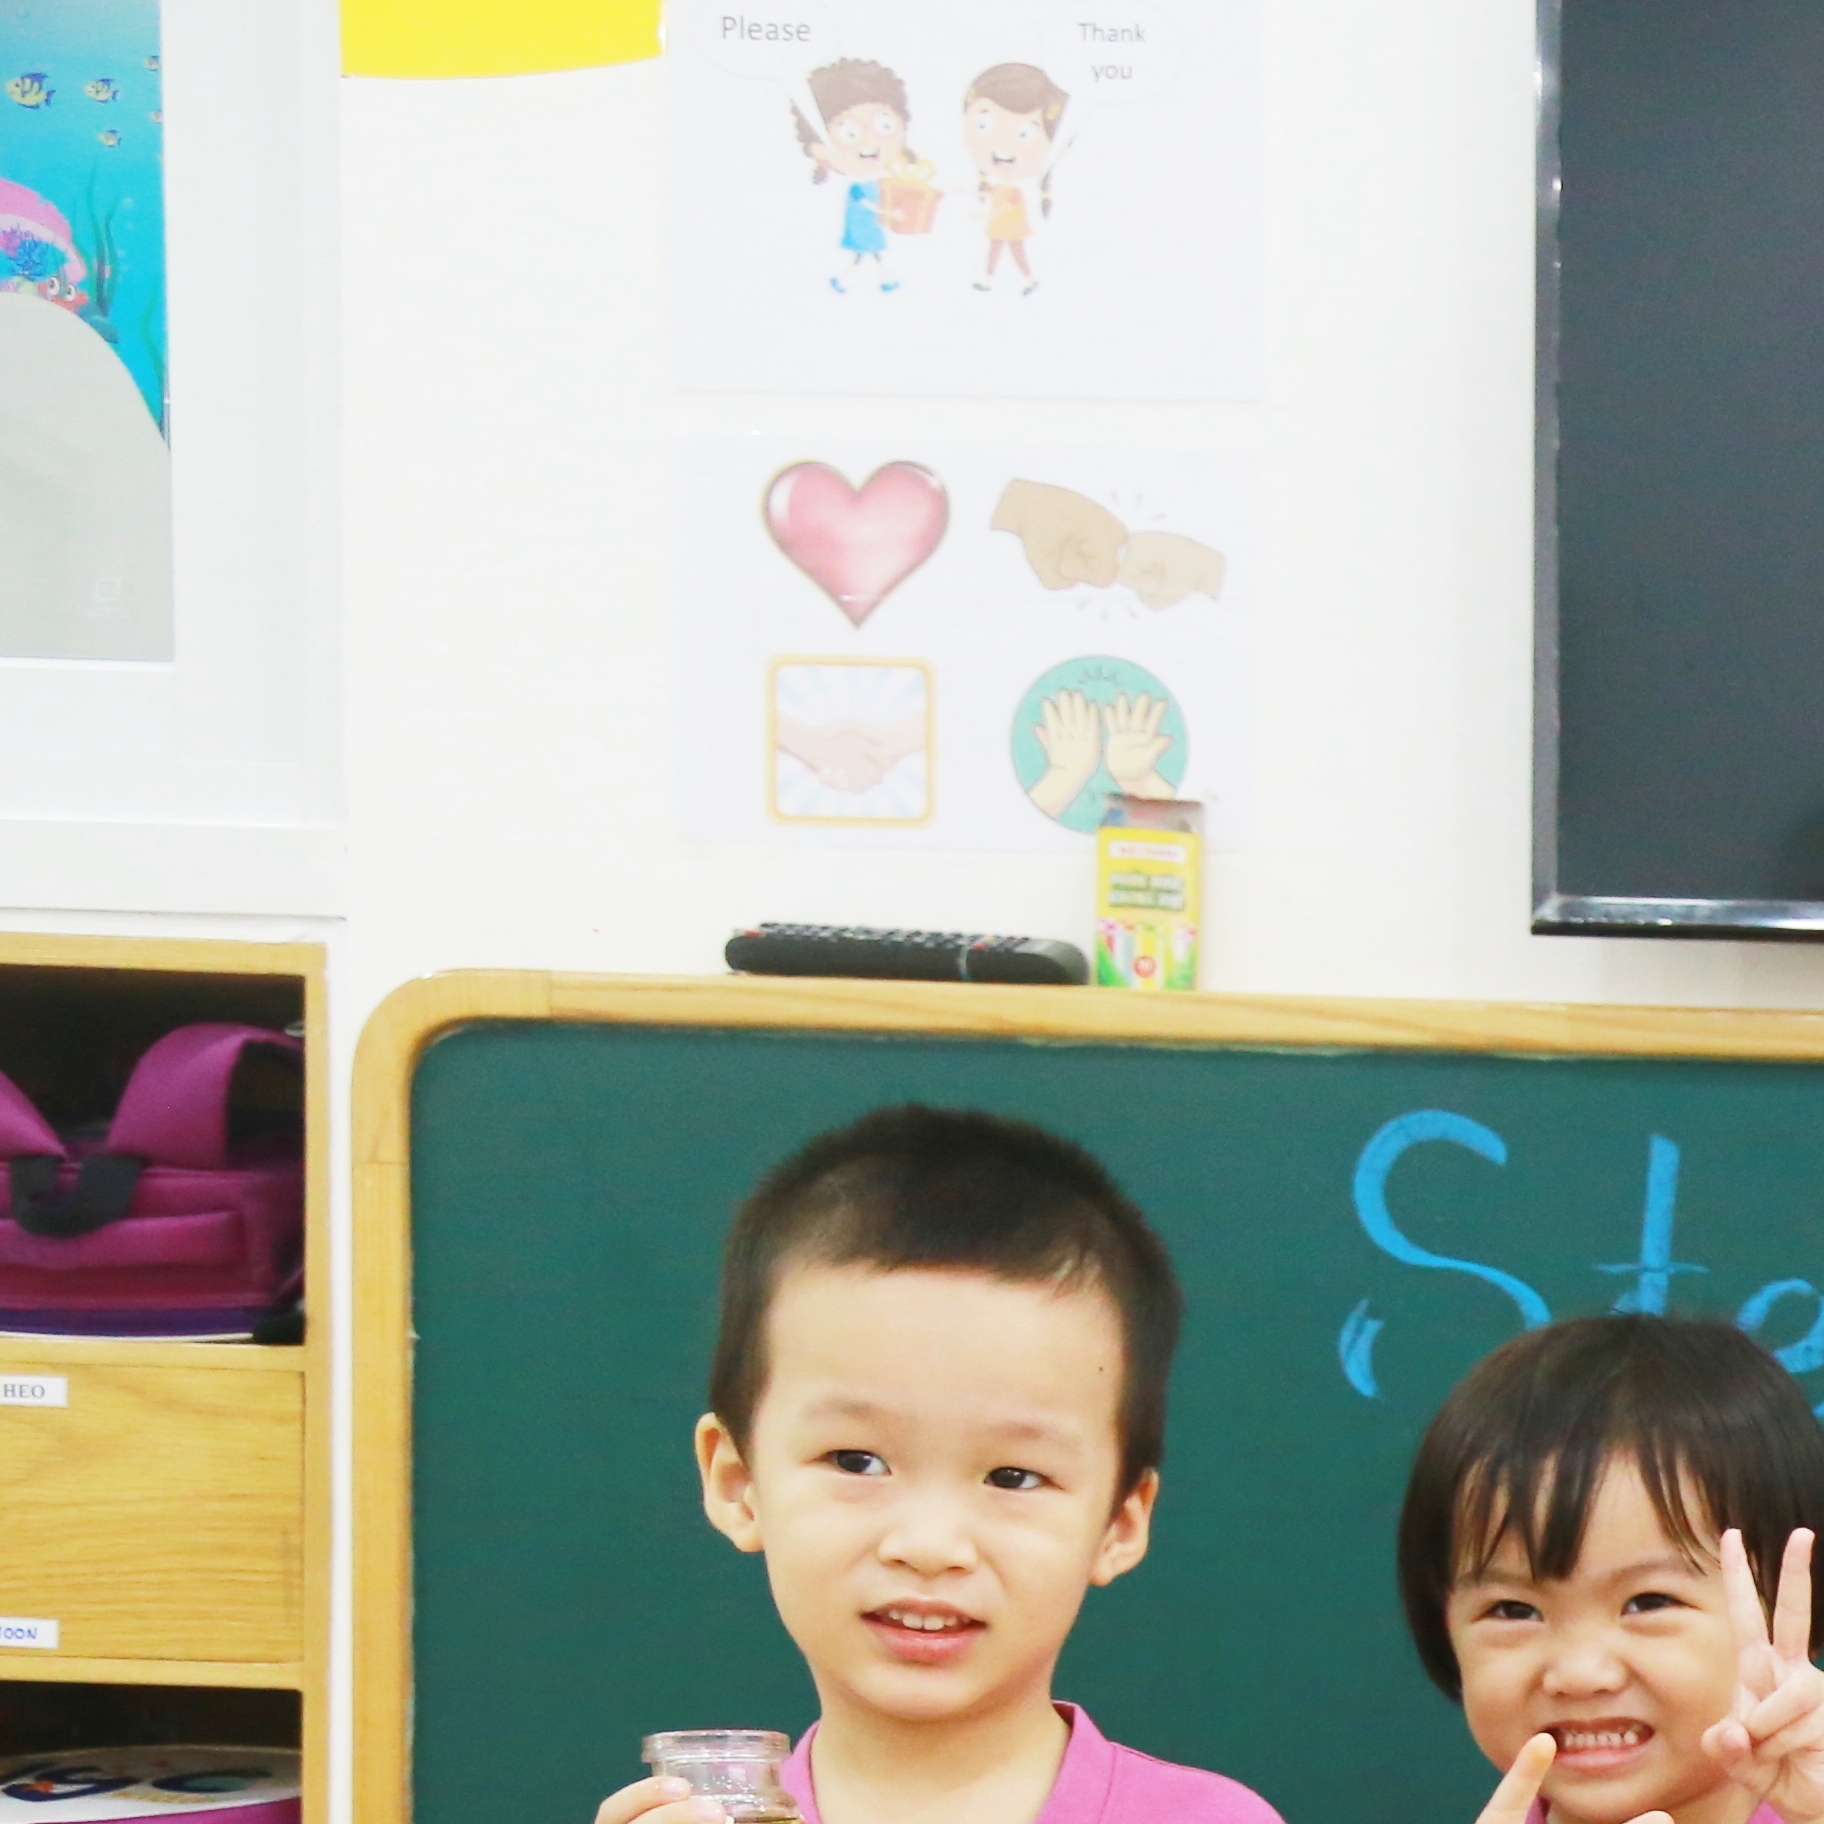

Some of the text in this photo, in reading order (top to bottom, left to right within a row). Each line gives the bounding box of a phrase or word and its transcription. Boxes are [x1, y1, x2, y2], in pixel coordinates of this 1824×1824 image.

[721, 15, 811, 42] Please
[1078, 22, 1147, 43] Thank
[1092, 66, 1133, 81] you
